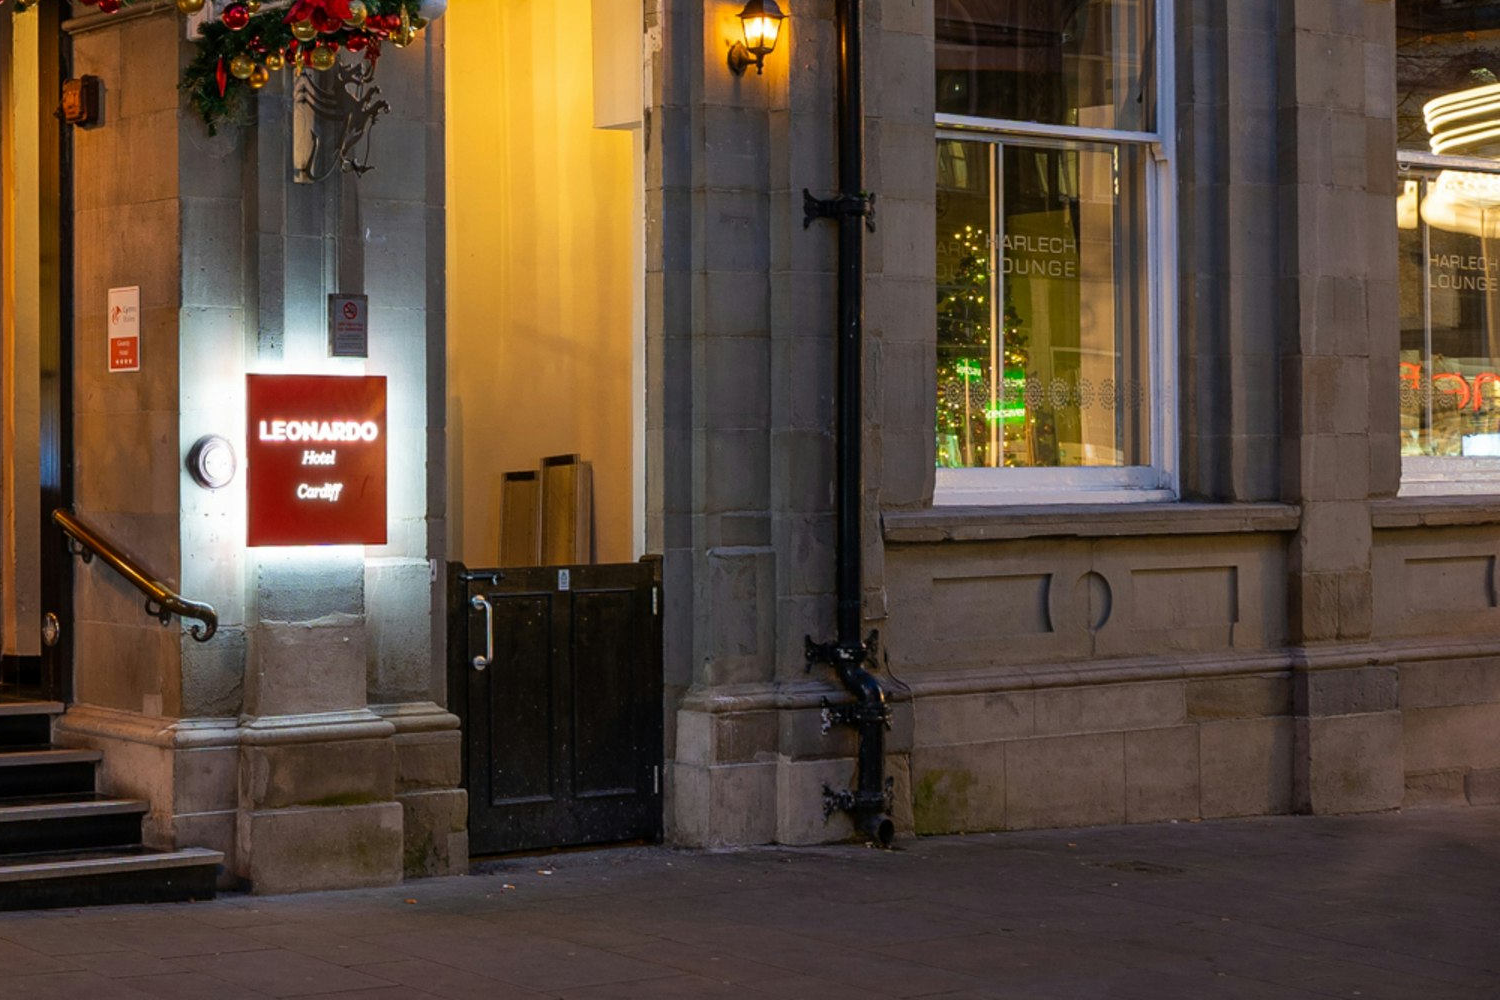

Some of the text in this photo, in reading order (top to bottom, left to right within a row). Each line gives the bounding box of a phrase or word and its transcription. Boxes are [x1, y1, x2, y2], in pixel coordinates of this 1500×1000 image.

[986, 233, 1077, 254] HARLECH
[986, 257, 1076, 278] LOUNGE
[1429, 254, 1499, 271] HARLECH
[1428, 274, 1499, 291] LOUNGE
[259, 420, 378, 441] LEONARDO
[301, 449, 336, 465] Hotel
[297, 482, 343, 502] Cardiff
